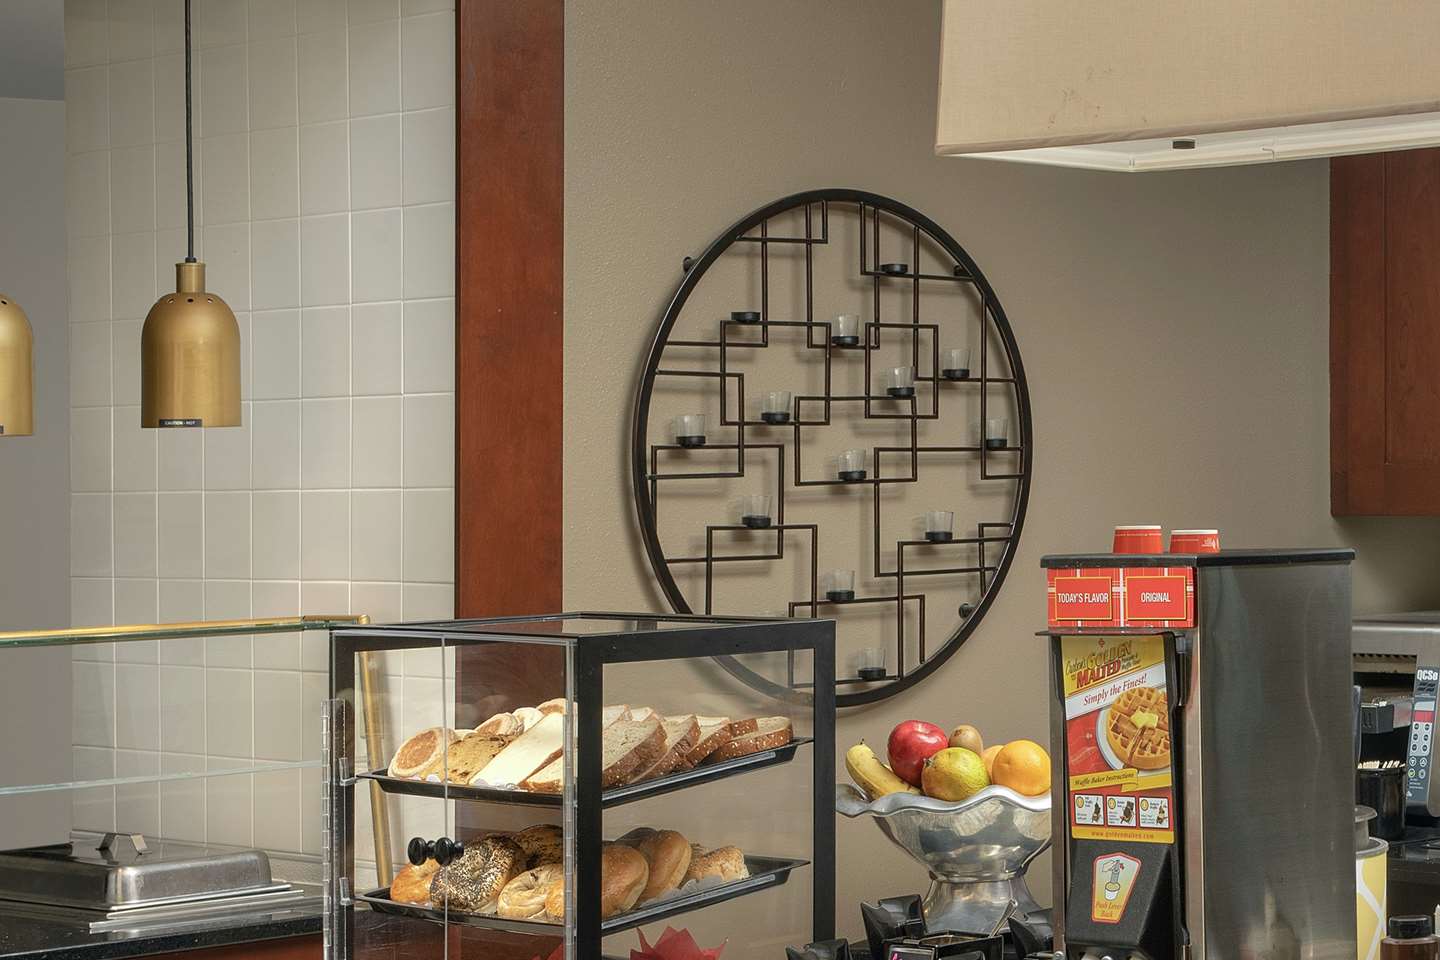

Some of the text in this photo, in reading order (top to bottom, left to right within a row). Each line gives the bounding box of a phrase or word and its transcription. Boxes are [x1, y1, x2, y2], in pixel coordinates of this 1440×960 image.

[1058, 592, 1109, 603] TODAY'S FLAVOR
[1140, 592, 1171, 603] ORIGINAL
[1076, 660, 1121, 688] MALTED
[1083, 673, 1147, 706] Simply the Finest!
